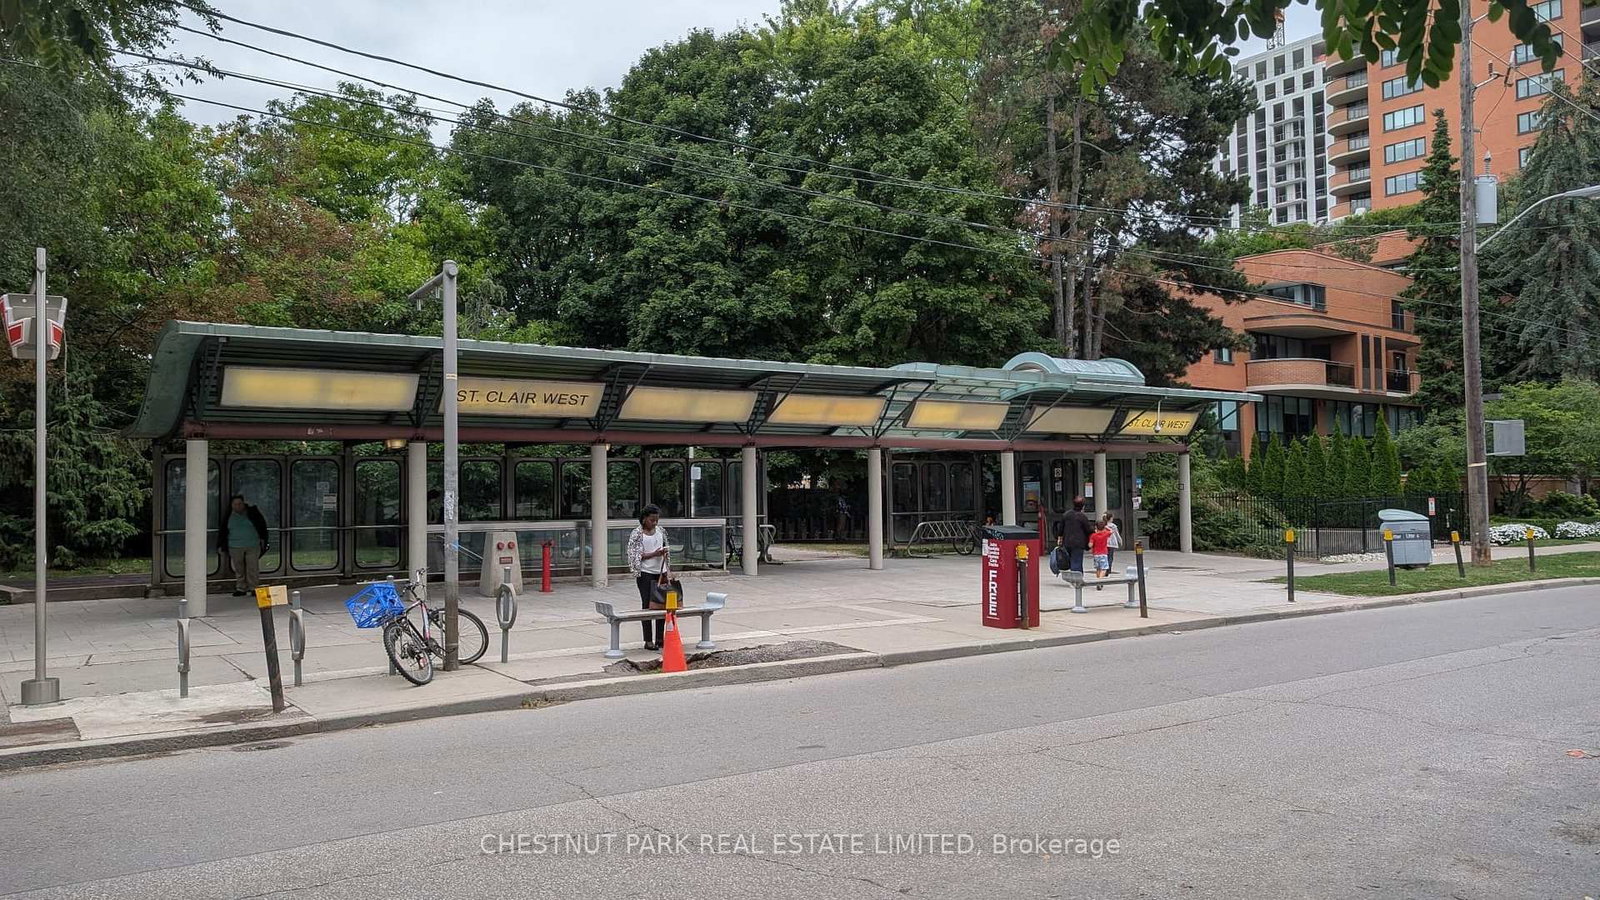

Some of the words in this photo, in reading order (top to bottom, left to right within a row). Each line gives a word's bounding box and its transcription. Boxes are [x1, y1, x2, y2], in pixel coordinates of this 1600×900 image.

[457, 389, 480, 402] ST.
[486, 390, 537, 404] CLAIR
[543, 393, 590, 406] WEST
[1141, 418, 1166, 428] CLAR
[1167, 420, 1190, 429] WEST
[989, 570, 998, 616] FREE
